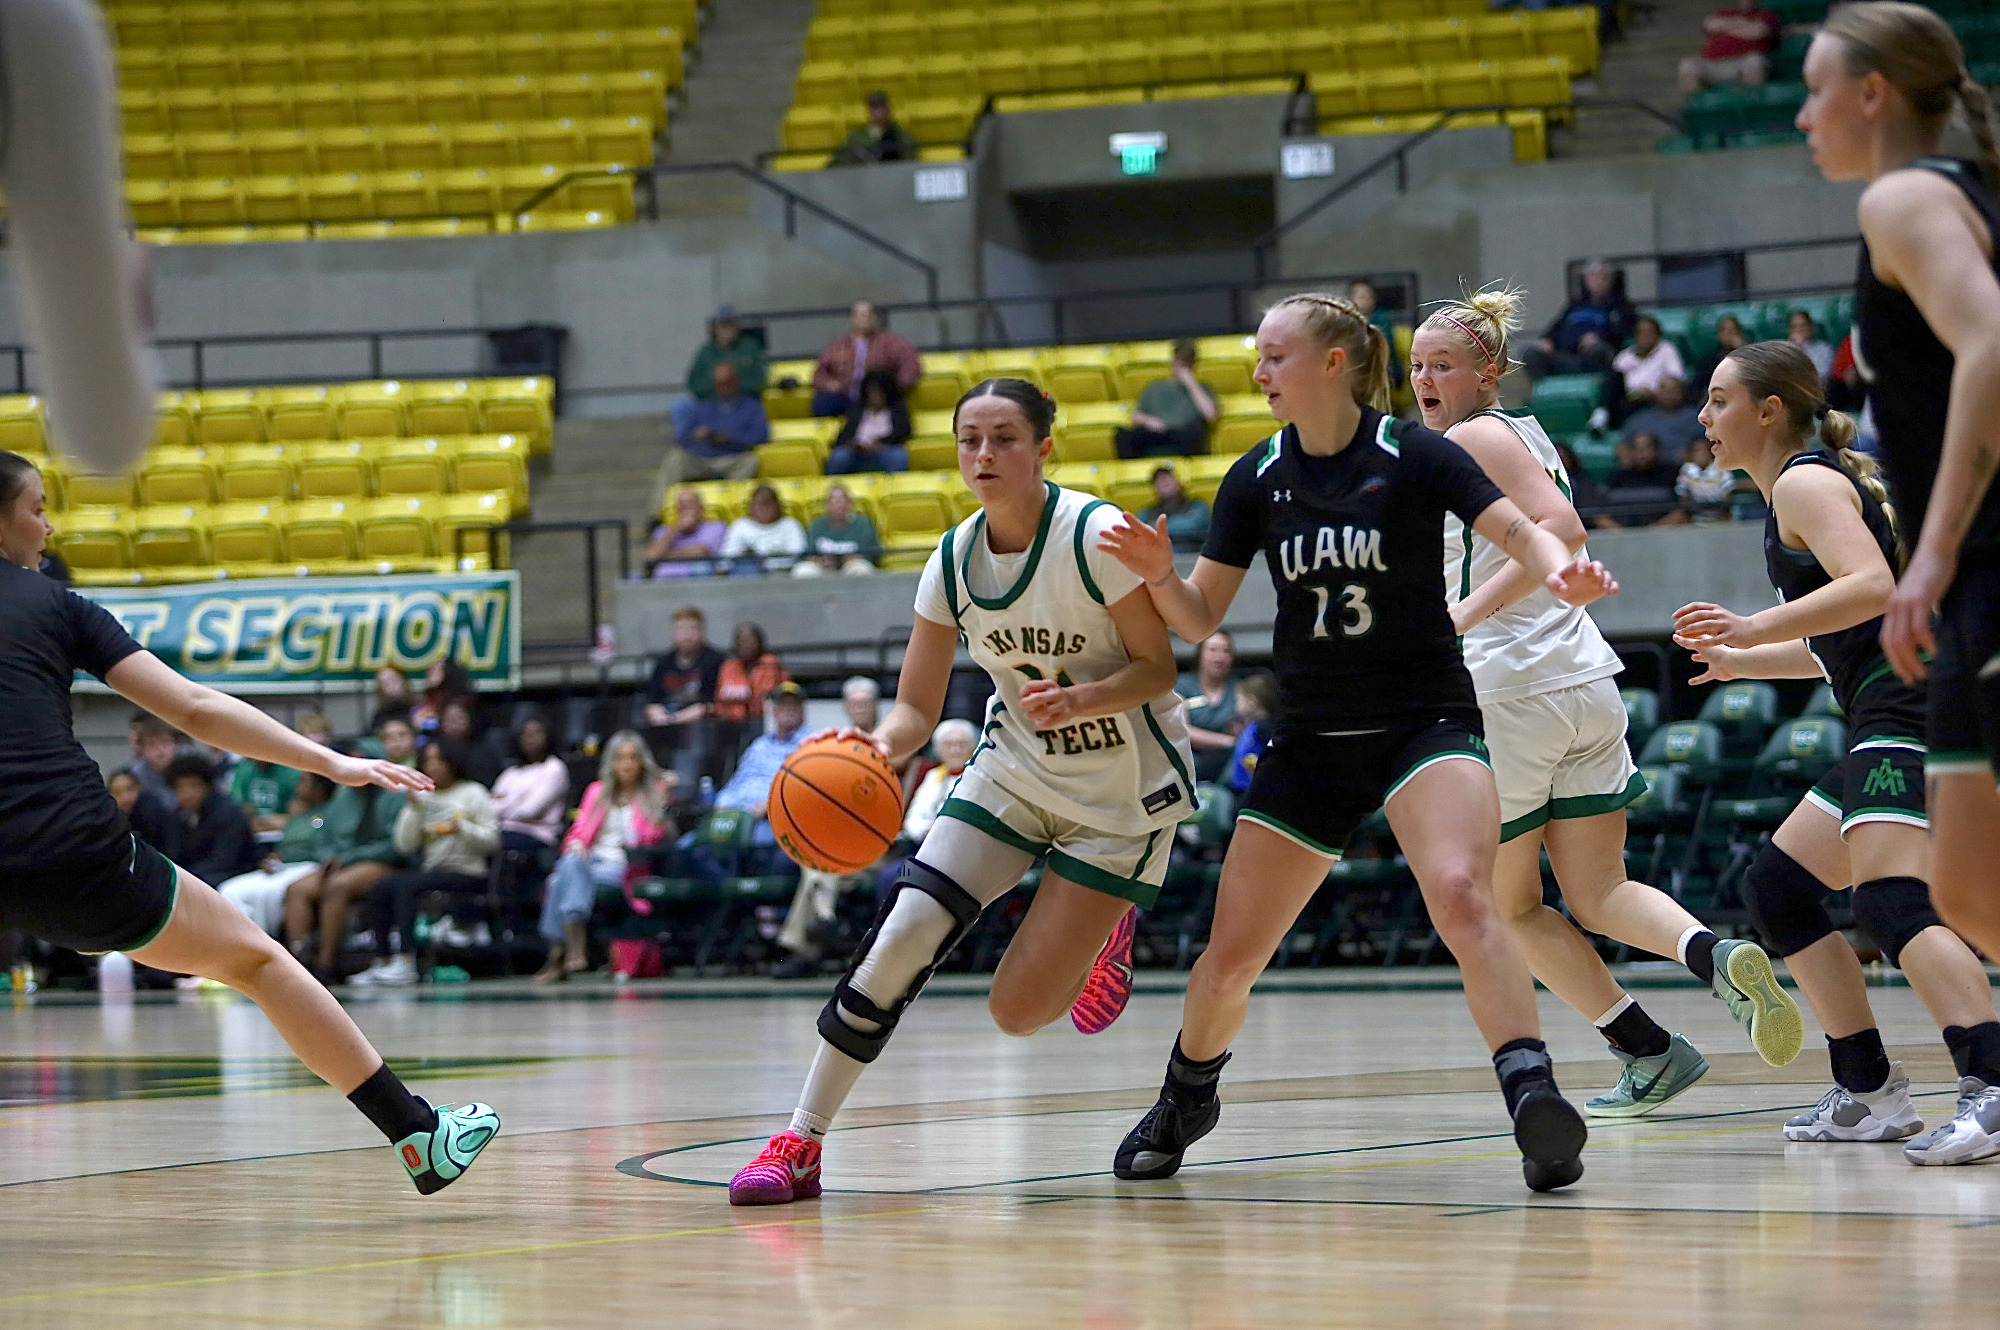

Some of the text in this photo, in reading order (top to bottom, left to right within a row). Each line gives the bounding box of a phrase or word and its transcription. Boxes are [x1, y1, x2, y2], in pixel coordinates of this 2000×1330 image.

[1280, 525, 1388, 581] UAM
[185, 592, 505, 673] SECTION
[1309, 584, 1373, 638] 13
[1036, 717, 1126, 755] TECH
